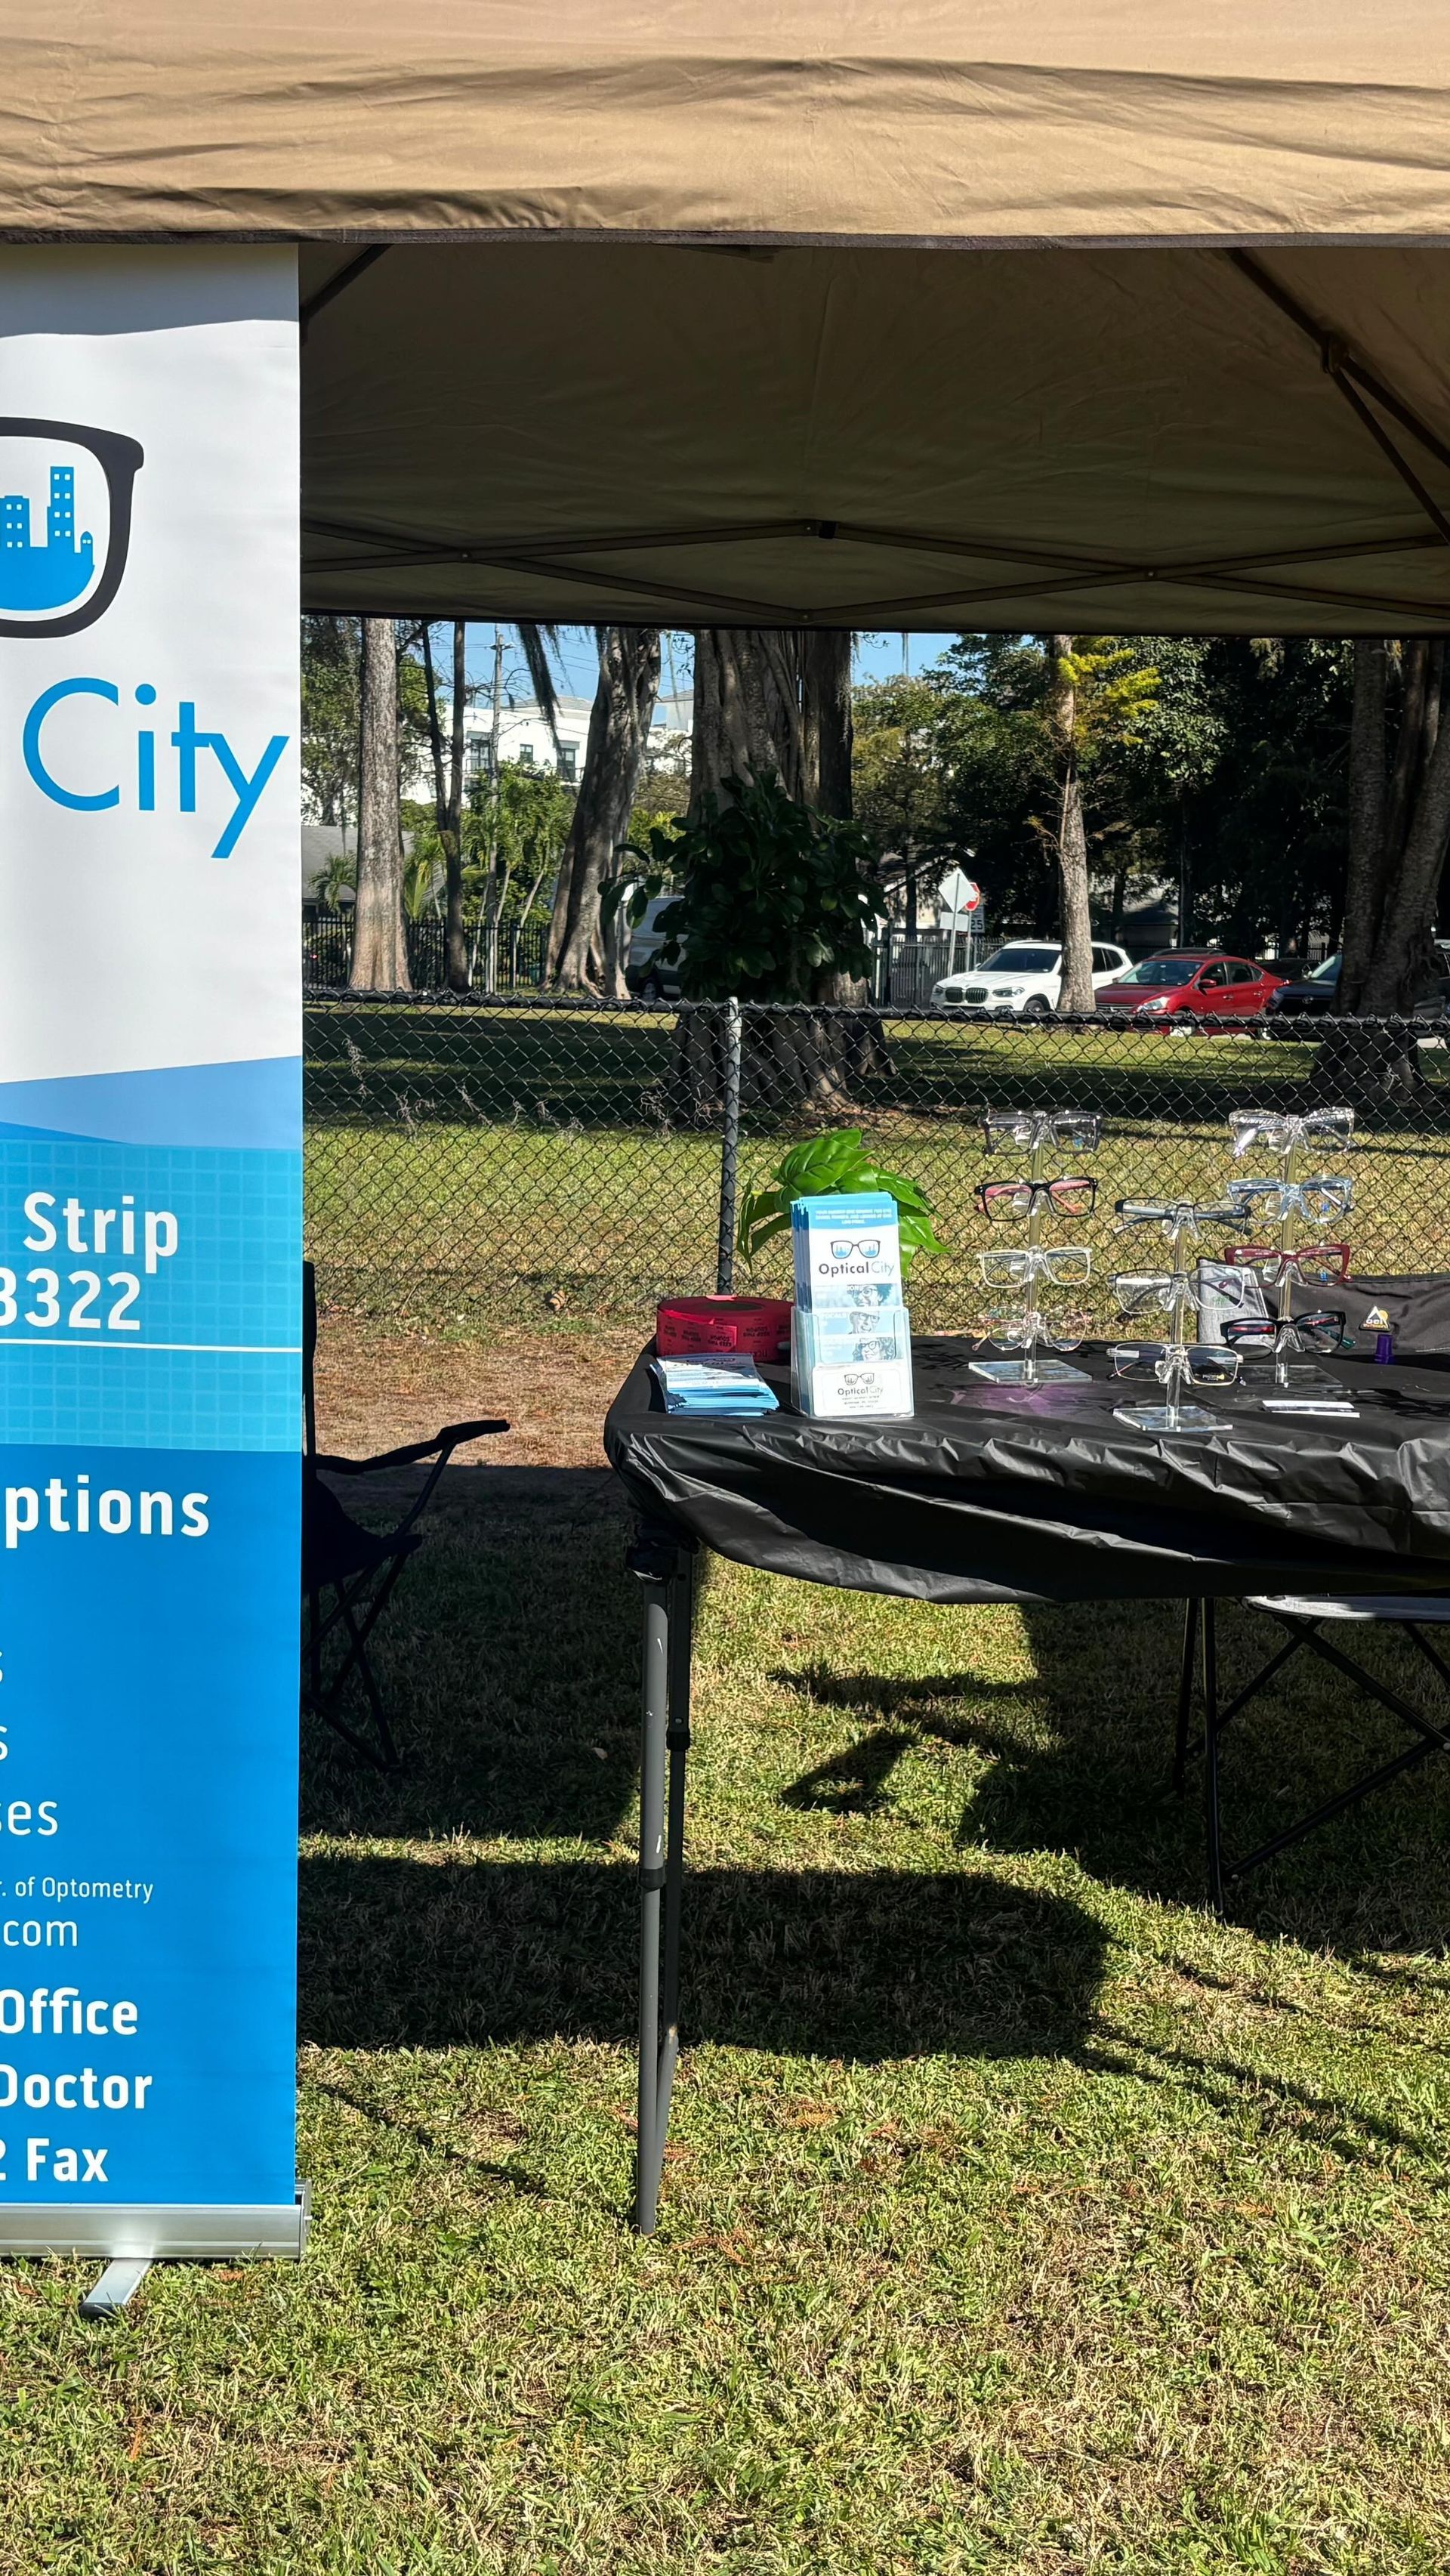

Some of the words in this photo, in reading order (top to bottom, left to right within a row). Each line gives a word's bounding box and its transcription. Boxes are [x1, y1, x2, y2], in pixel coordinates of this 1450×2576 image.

[23, 677, 288, 859] City
[970, 919, 983, 930] 25
[23, 1191, 178, 1274] Strip
[818, 1262, 869, 1278] Optical
[5, 1475, 209, 1549] ptions
[0, 1800, 58, 1836] es
[15, 1876, 35, 1897] of
[42, 1877, 153, 1904] Optometry
[0, 1987, 137, 2035] Office
[0, 2064, 153, 2109] Doctor
[27, 2138, 108, 2182] Fax
